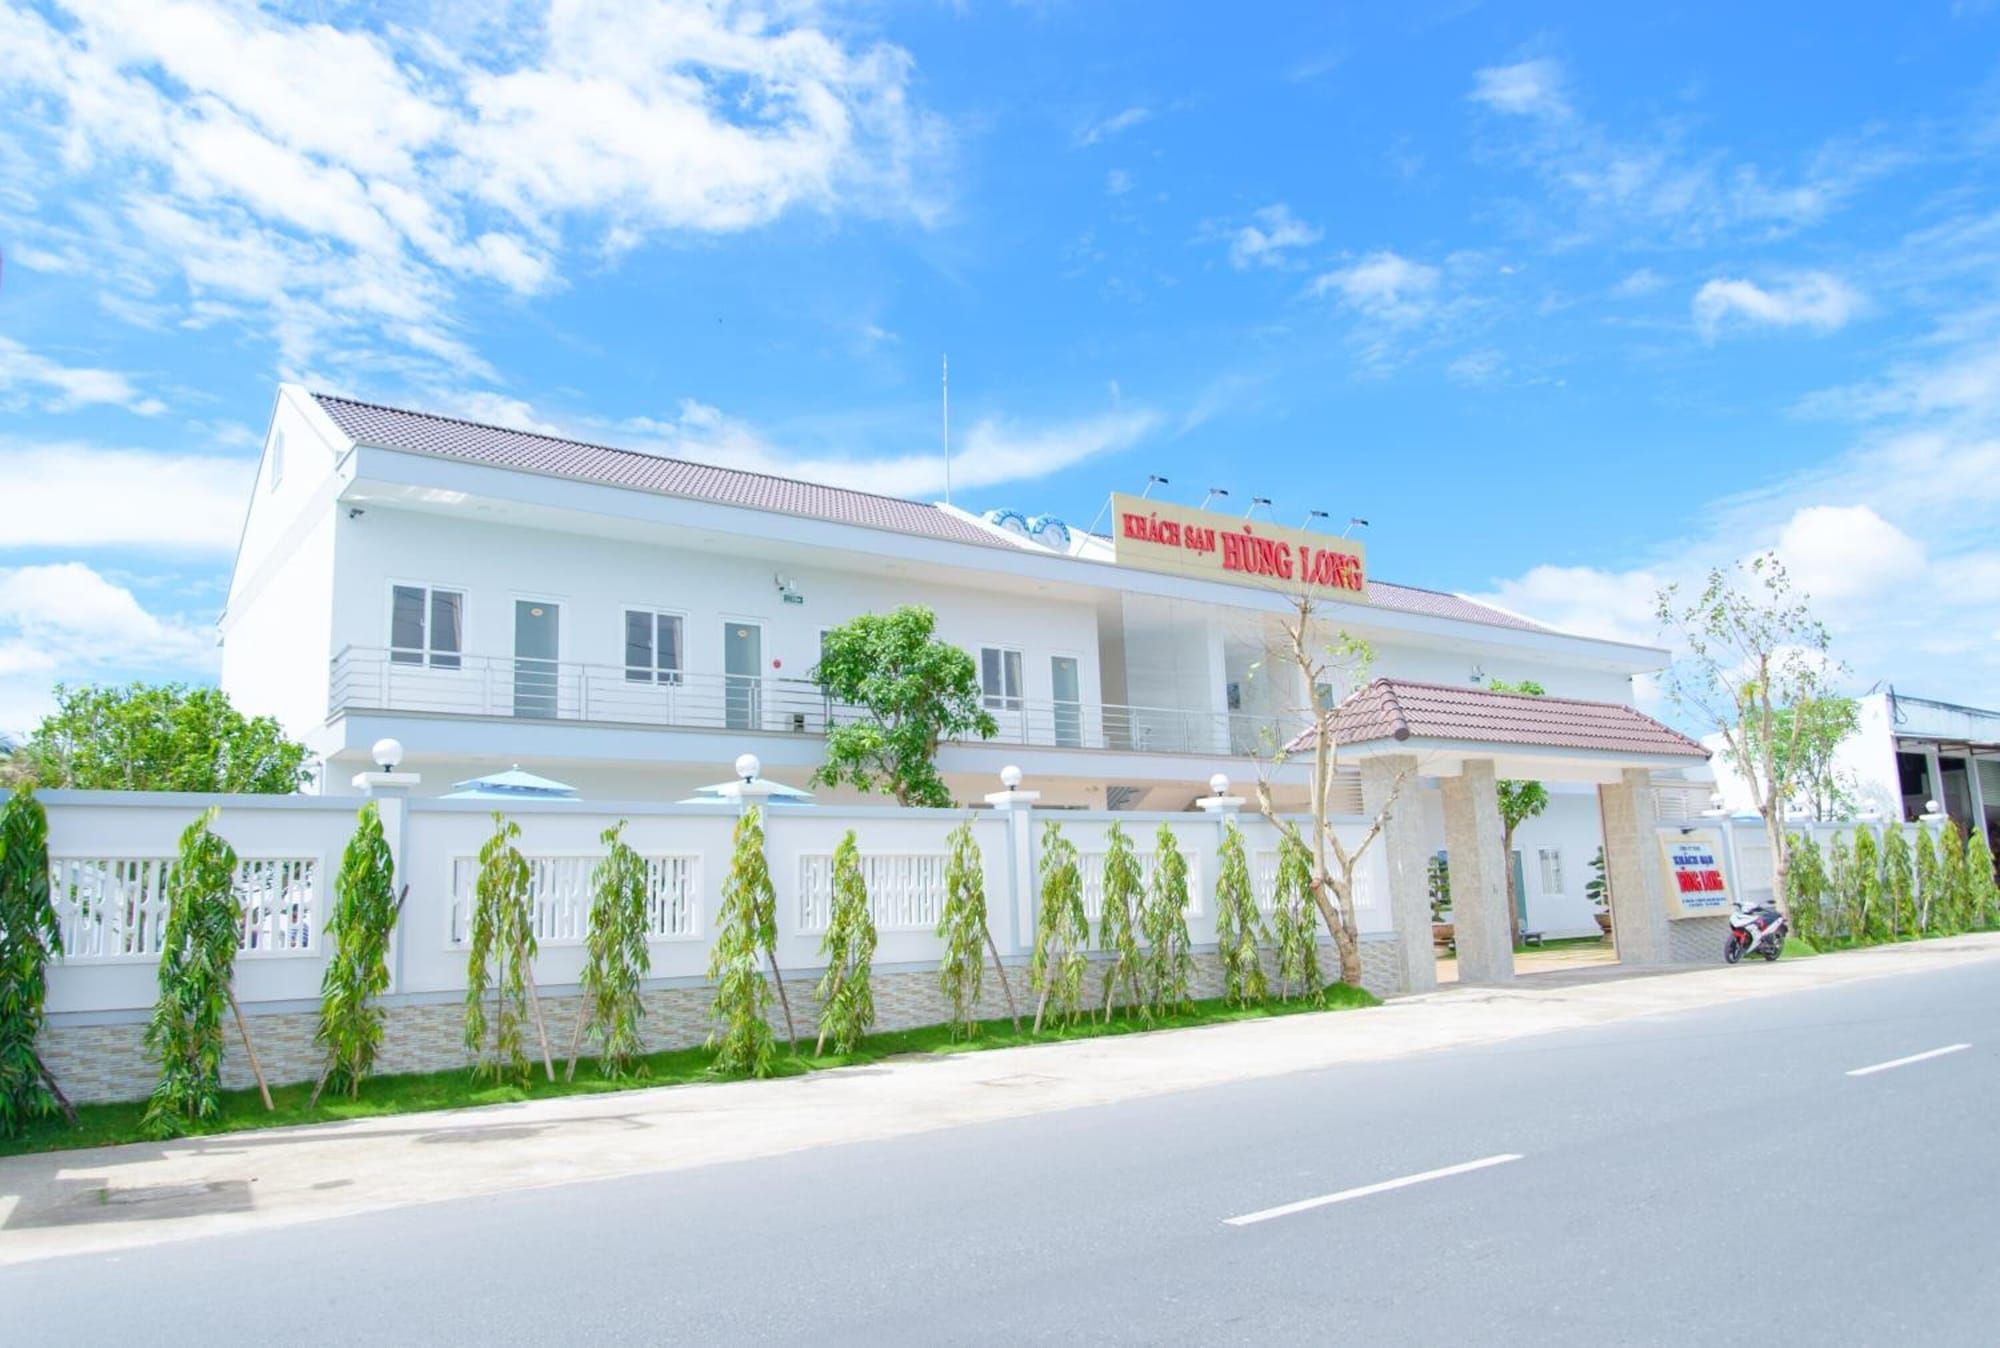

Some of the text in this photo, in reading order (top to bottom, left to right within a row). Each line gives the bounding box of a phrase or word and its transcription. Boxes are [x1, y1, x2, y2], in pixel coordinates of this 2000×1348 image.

[1122, 512, 1363, 591] KHÁCH SẠN HÙNG LONG
